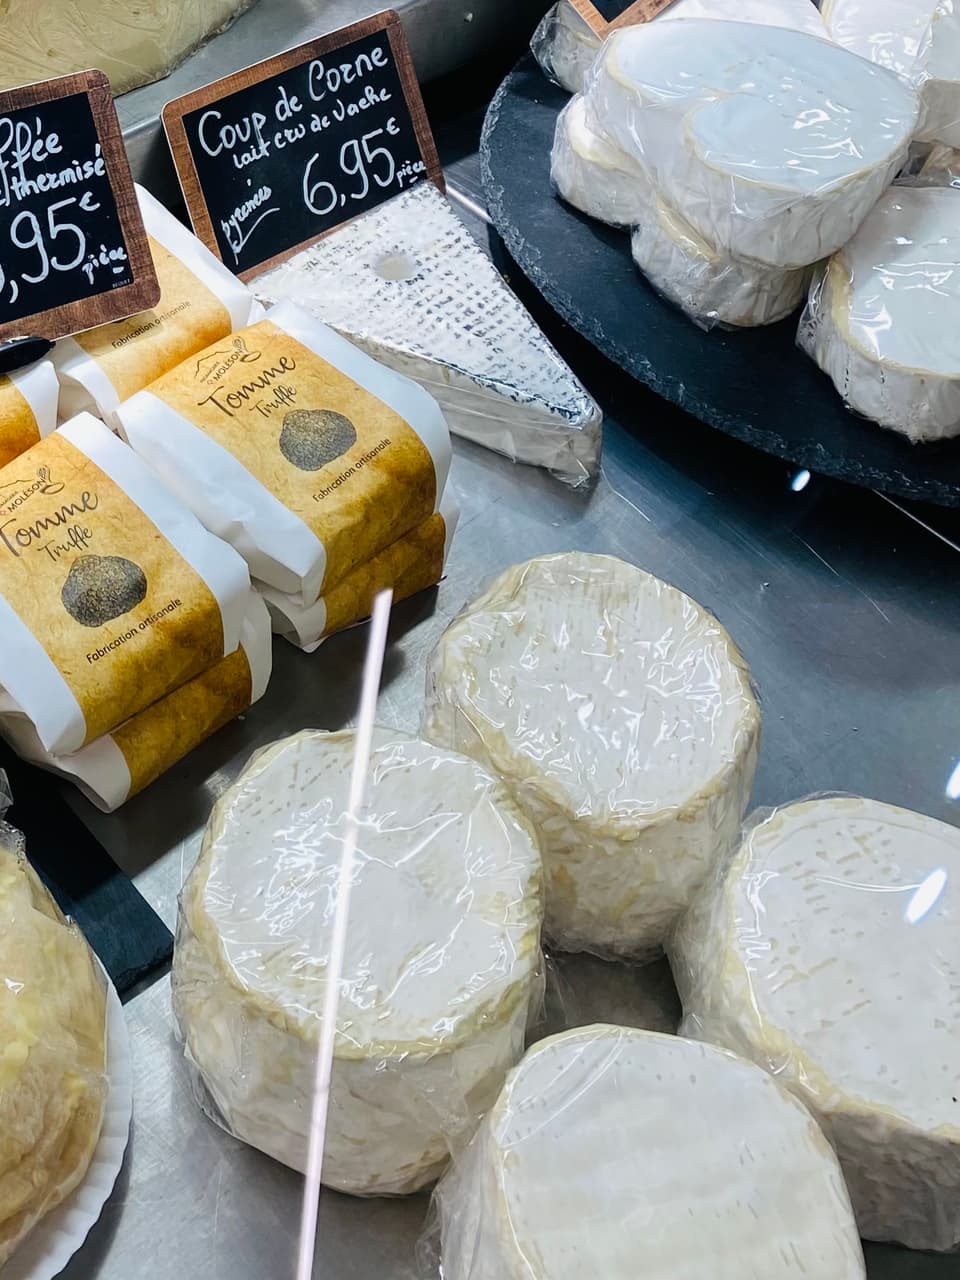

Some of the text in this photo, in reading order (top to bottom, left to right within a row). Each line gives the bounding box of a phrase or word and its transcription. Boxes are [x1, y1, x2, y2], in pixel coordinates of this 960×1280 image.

[198, 46, 389, 157] Coup de Corne
[233, 140, 271, 168] lait
[310, 113, 330, 133] de
[111, 300, 192, 351] Fabrication artisanale
[197, 355, 296, 417] Tomme
[249, 384, 297, 418] Truffe
[312, 438, 392, 503] Fabrication artisanale
[37, 524, 93, 562] Truffe
[86, 598, 182, 664] Fabrication artisanale
